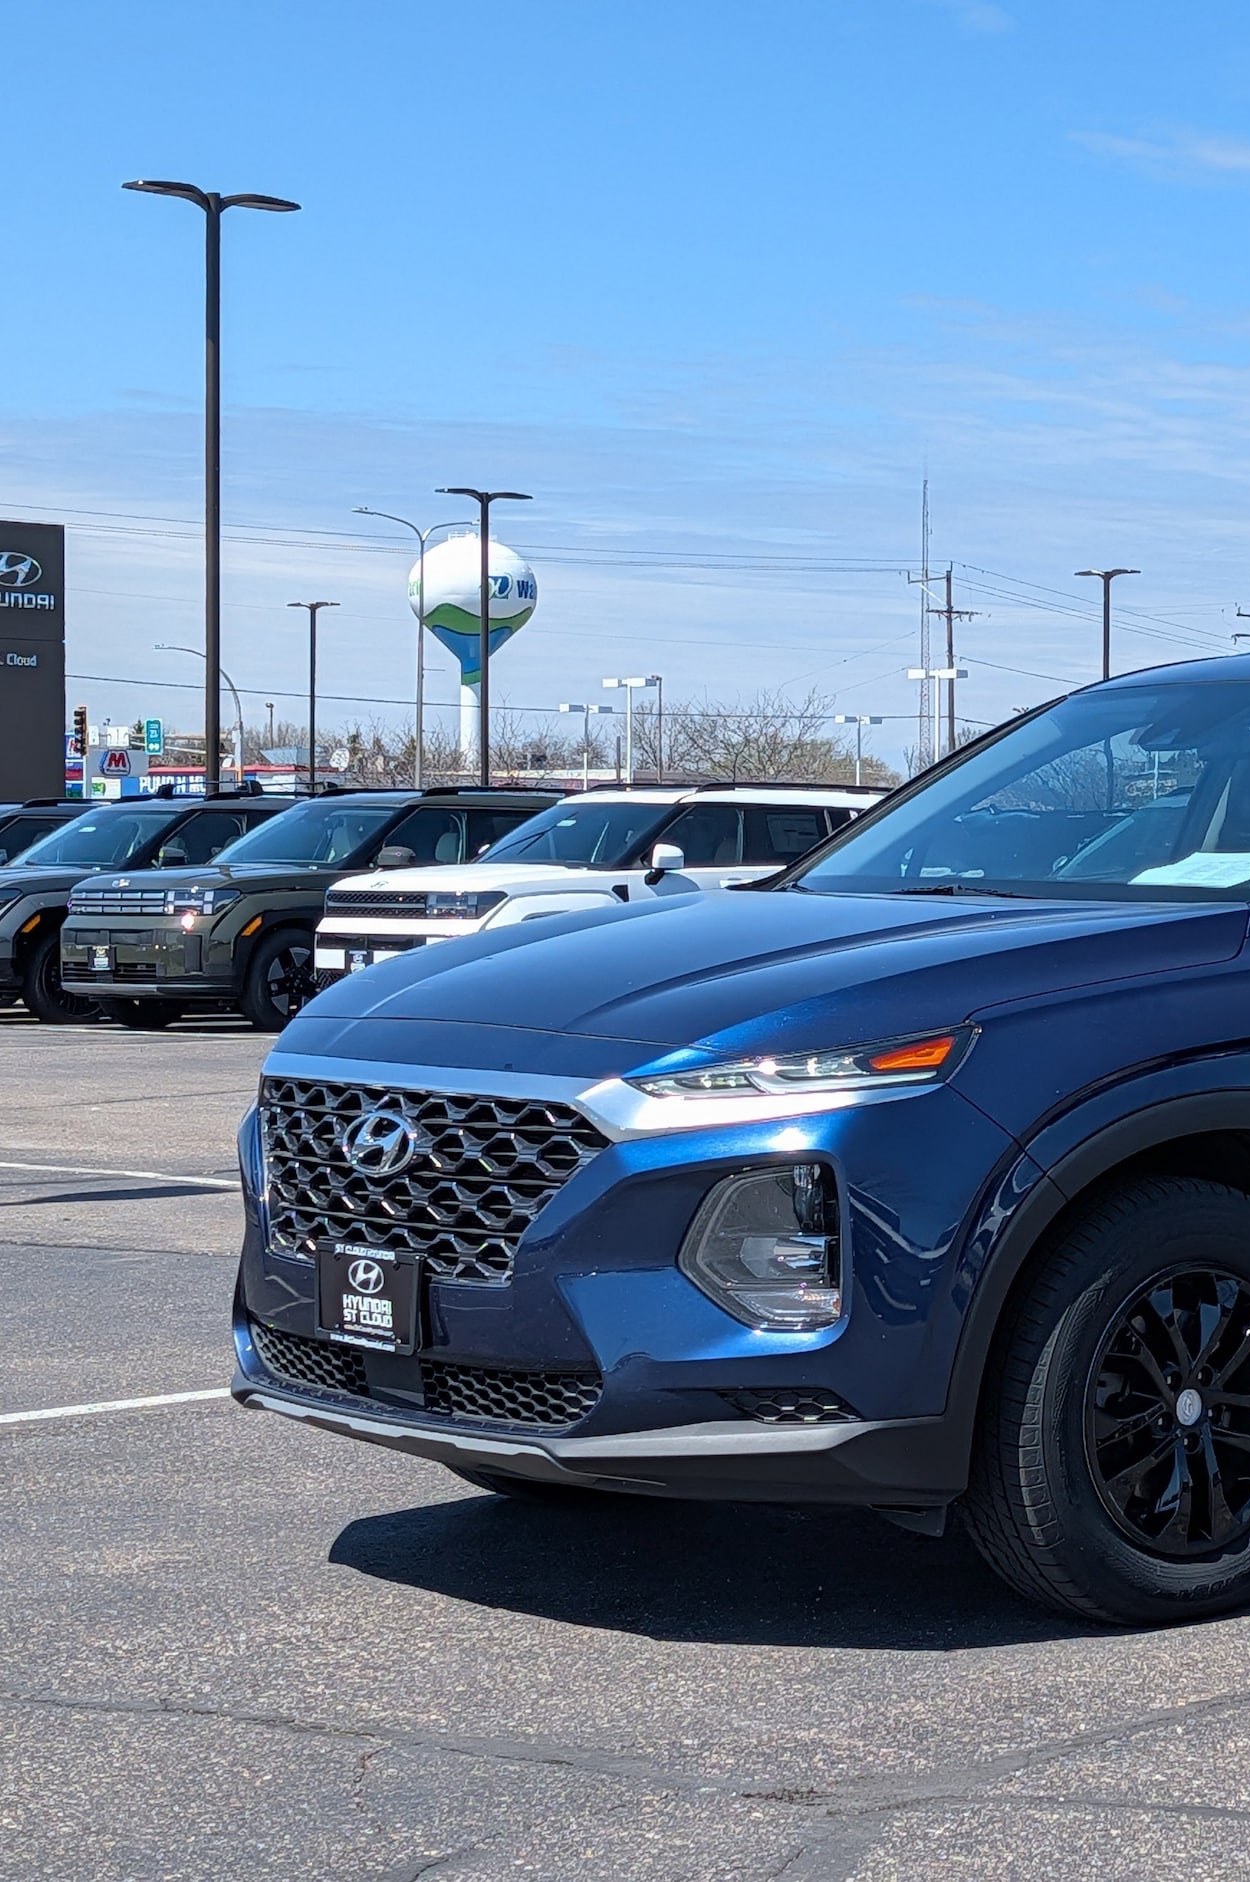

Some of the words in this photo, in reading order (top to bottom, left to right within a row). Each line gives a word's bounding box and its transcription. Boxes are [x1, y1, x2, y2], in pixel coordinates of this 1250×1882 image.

[6, 653, 37, 667] Cloud
[342, 1294, 392, 1315] HYUNDAI
[343, 1308, 358, 1322] ST
[360, 1311, 393, 1328] CLOUD
